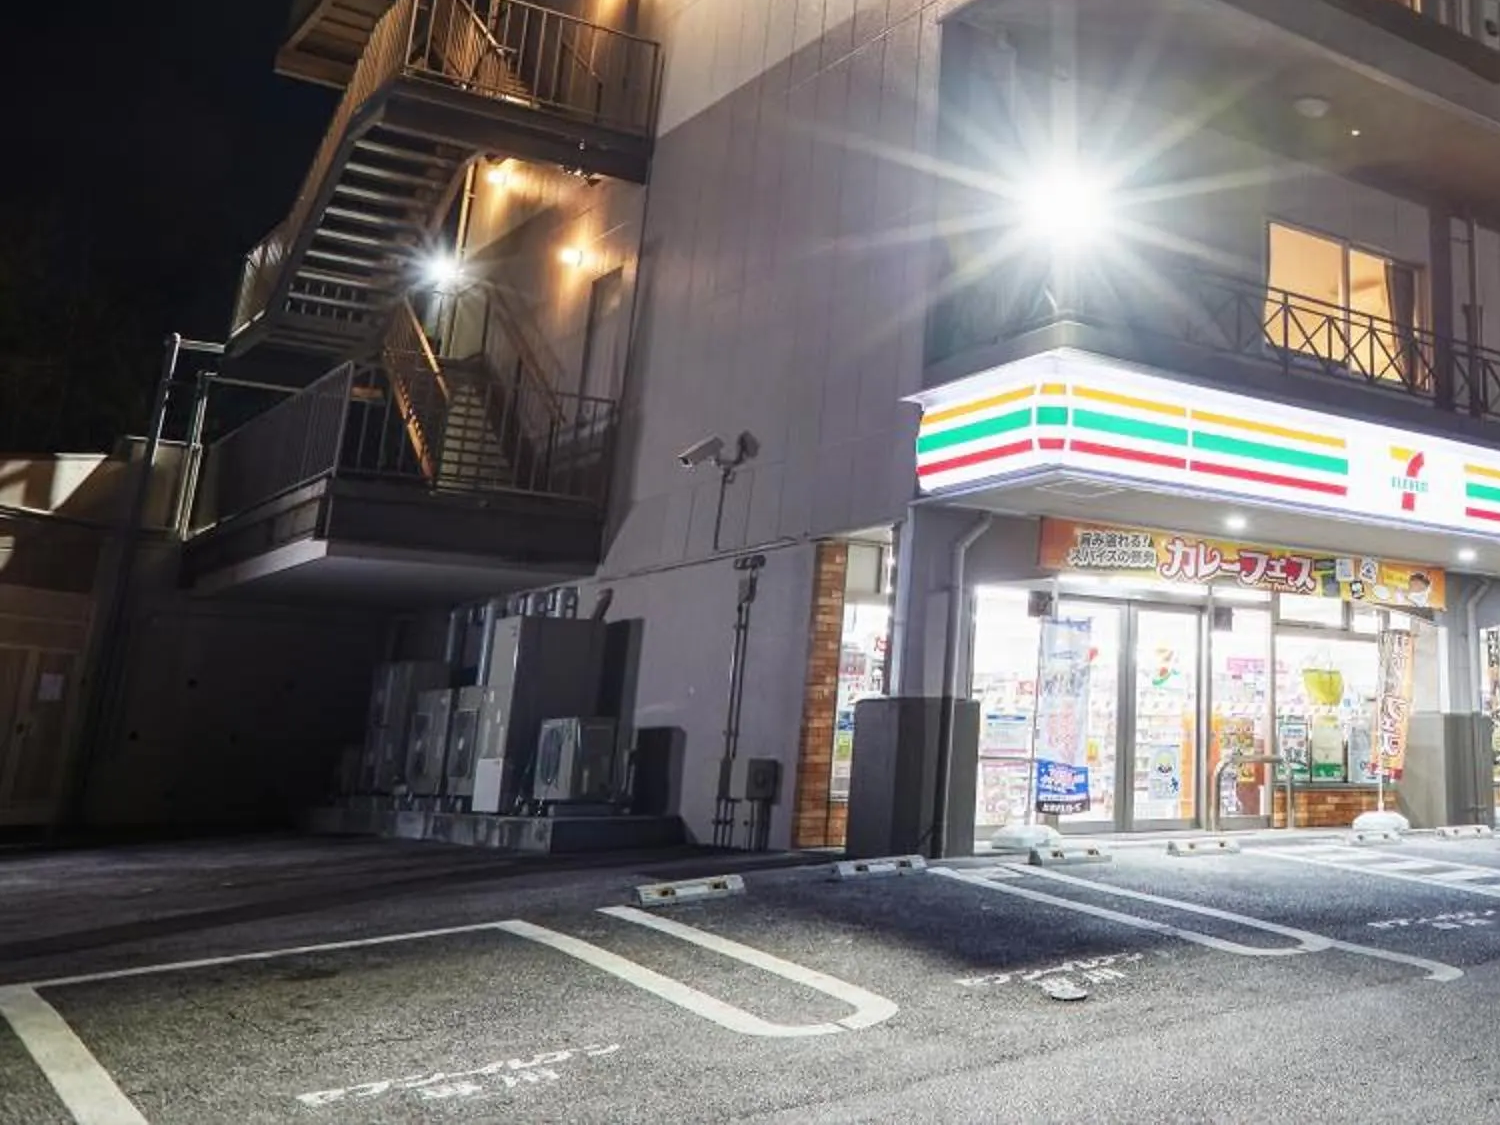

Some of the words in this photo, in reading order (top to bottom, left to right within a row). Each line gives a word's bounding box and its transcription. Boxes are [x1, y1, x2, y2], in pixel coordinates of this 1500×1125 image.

[1160, 537, 1317, 592] カレーフェス
